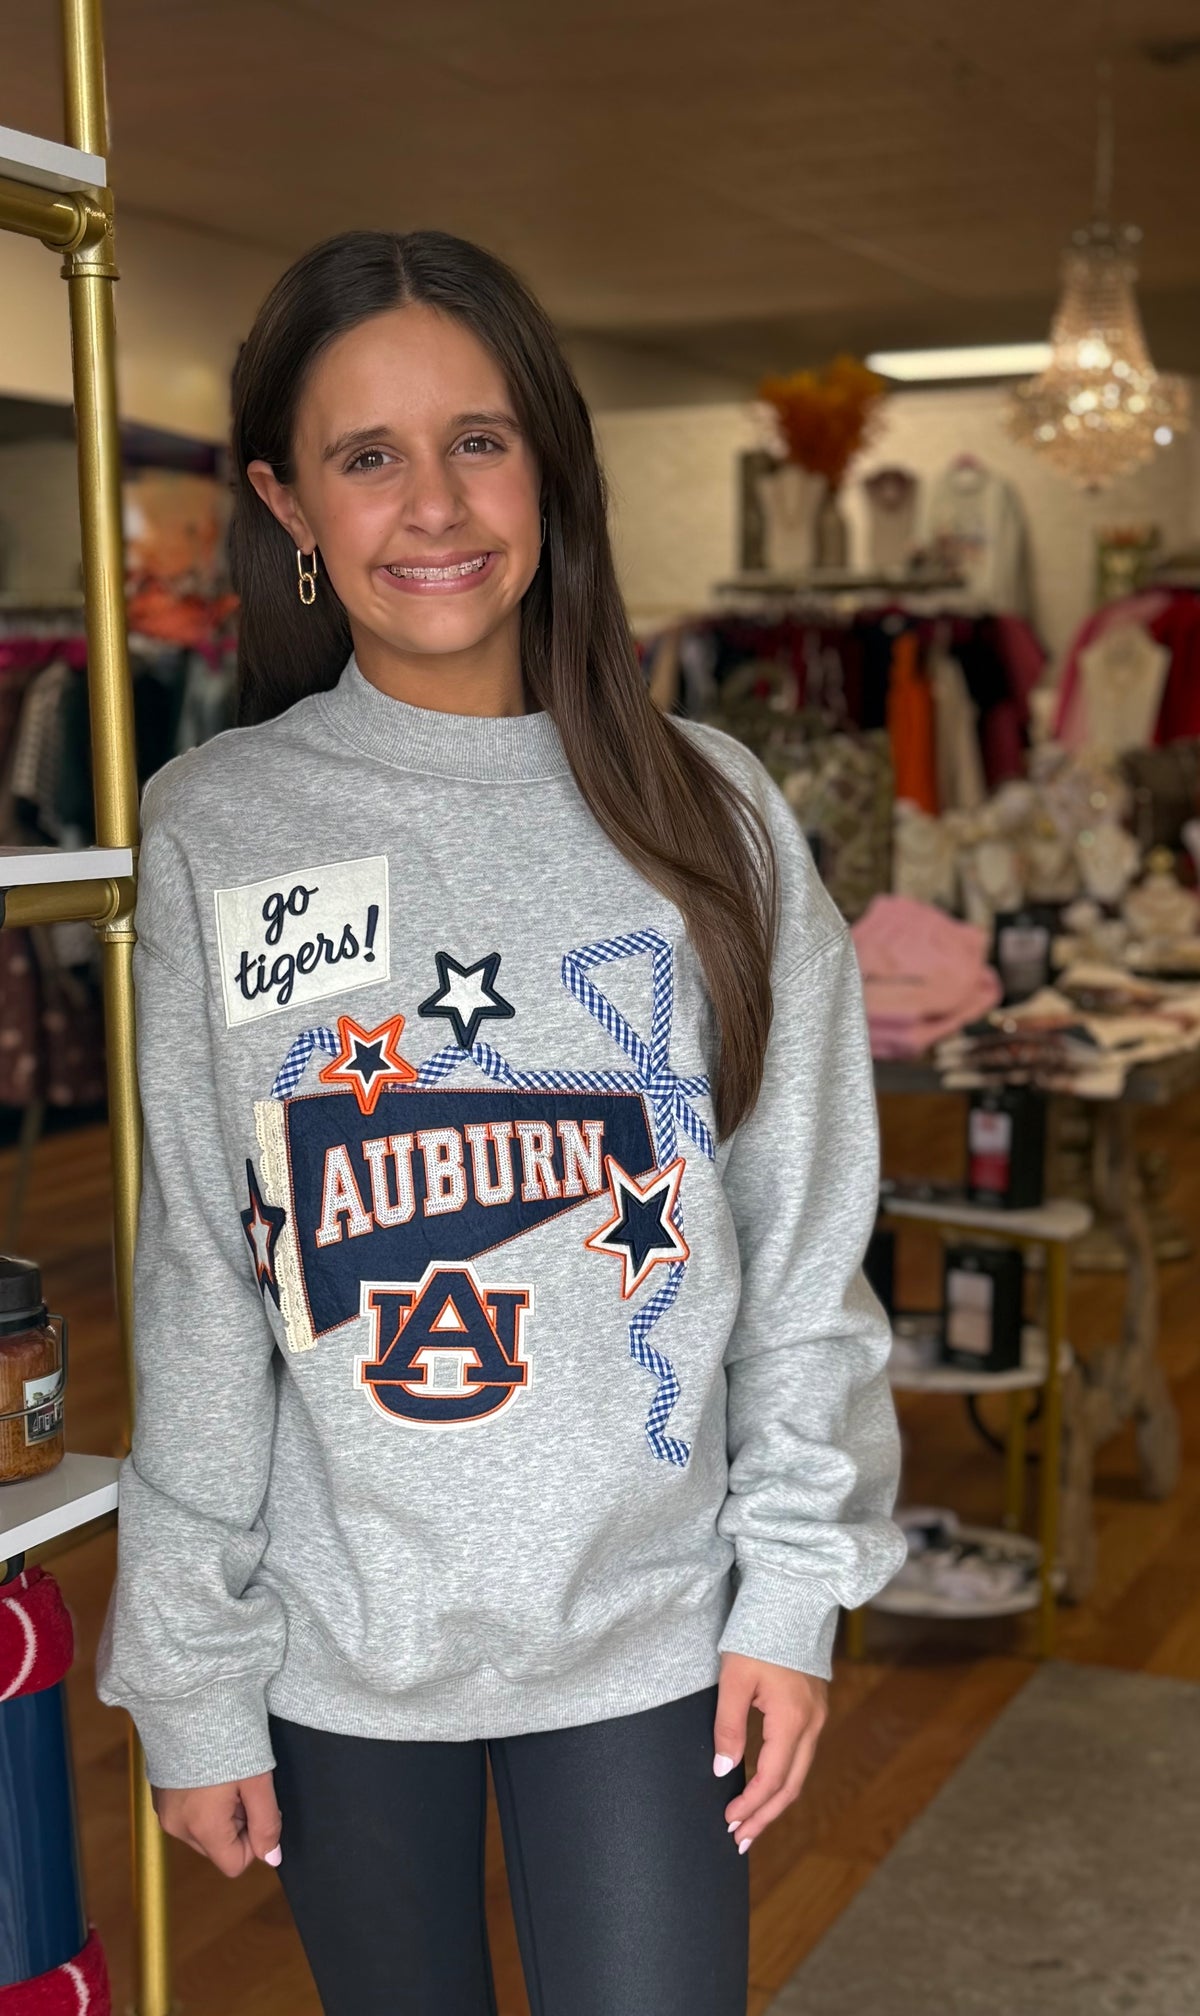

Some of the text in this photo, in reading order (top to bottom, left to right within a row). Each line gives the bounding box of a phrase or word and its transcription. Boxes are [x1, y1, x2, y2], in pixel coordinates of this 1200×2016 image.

[234, 904, 380, 1005] tigers!
[263, 885, 319, 945] go
[316, 1119, 604, 1248] AUBURN
